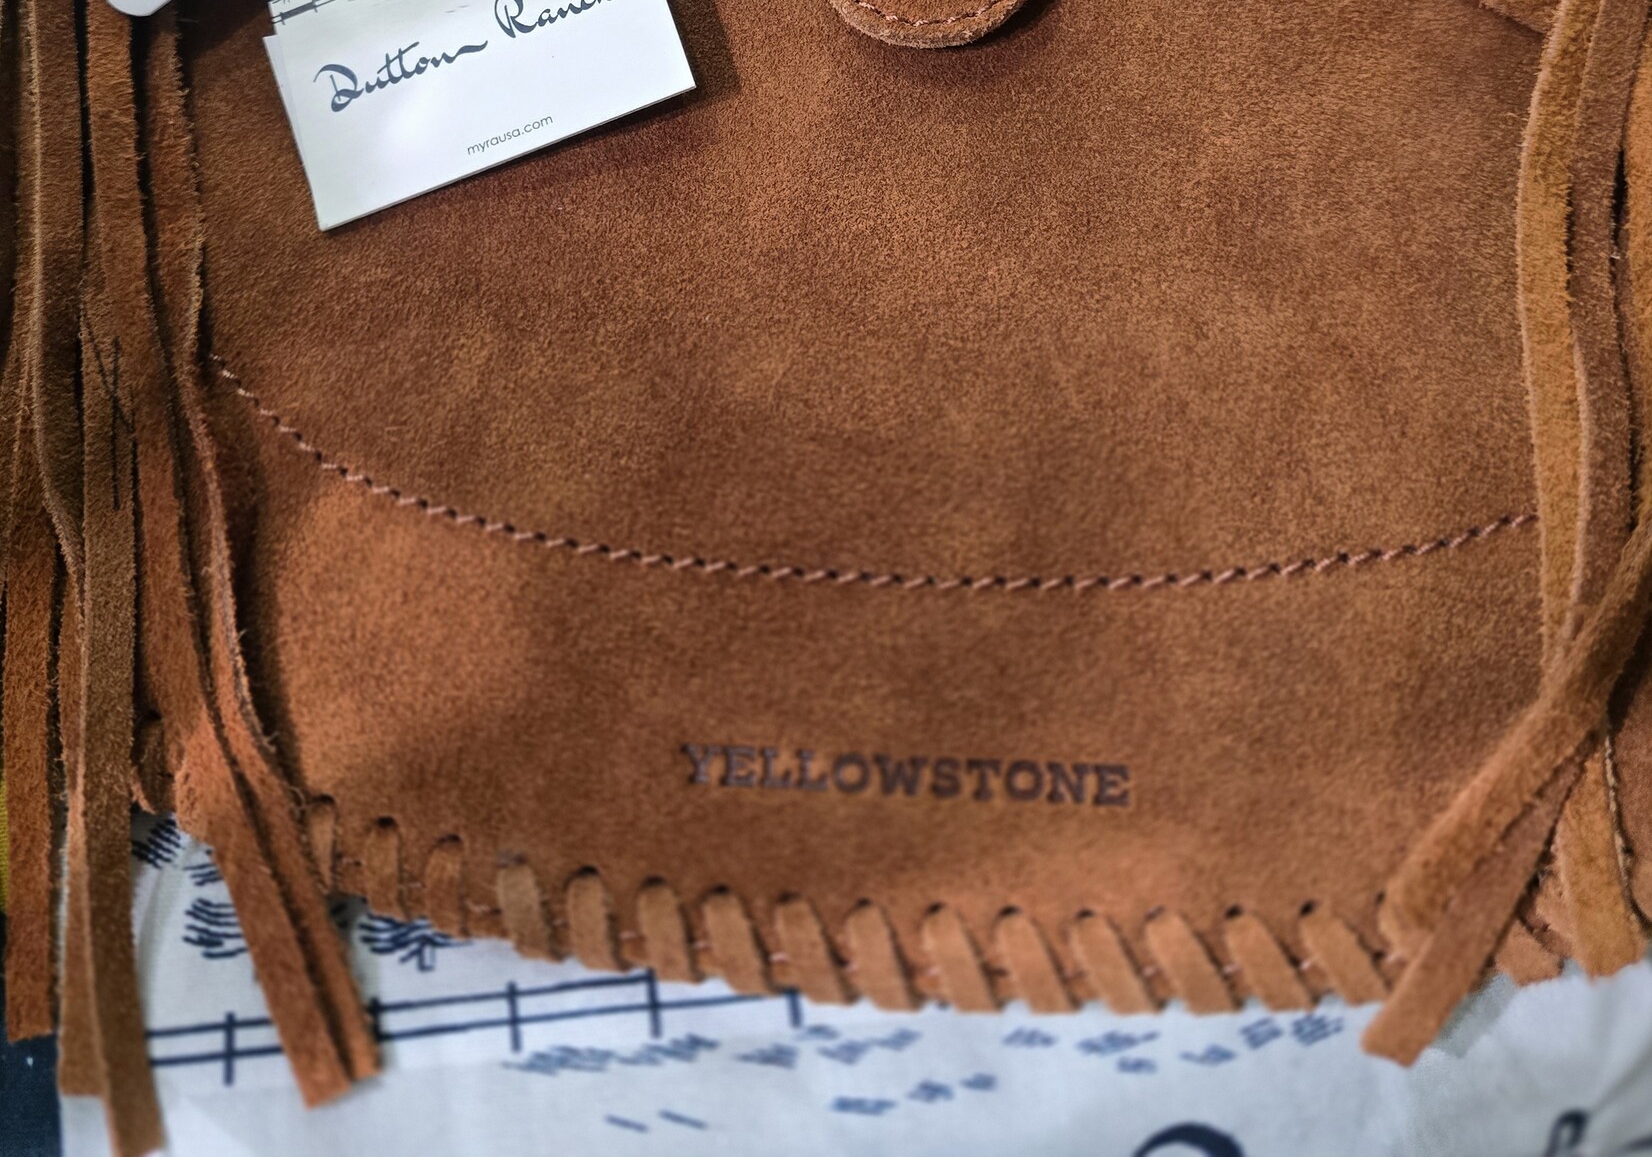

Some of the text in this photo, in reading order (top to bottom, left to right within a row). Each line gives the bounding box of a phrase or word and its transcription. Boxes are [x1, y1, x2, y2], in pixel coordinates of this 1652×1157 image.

[313, 40, 488, 112] Dutton
[467, 115, 554, 155] myrausa.com
[681, 744, 1131, 807] YELLOWSTONE
